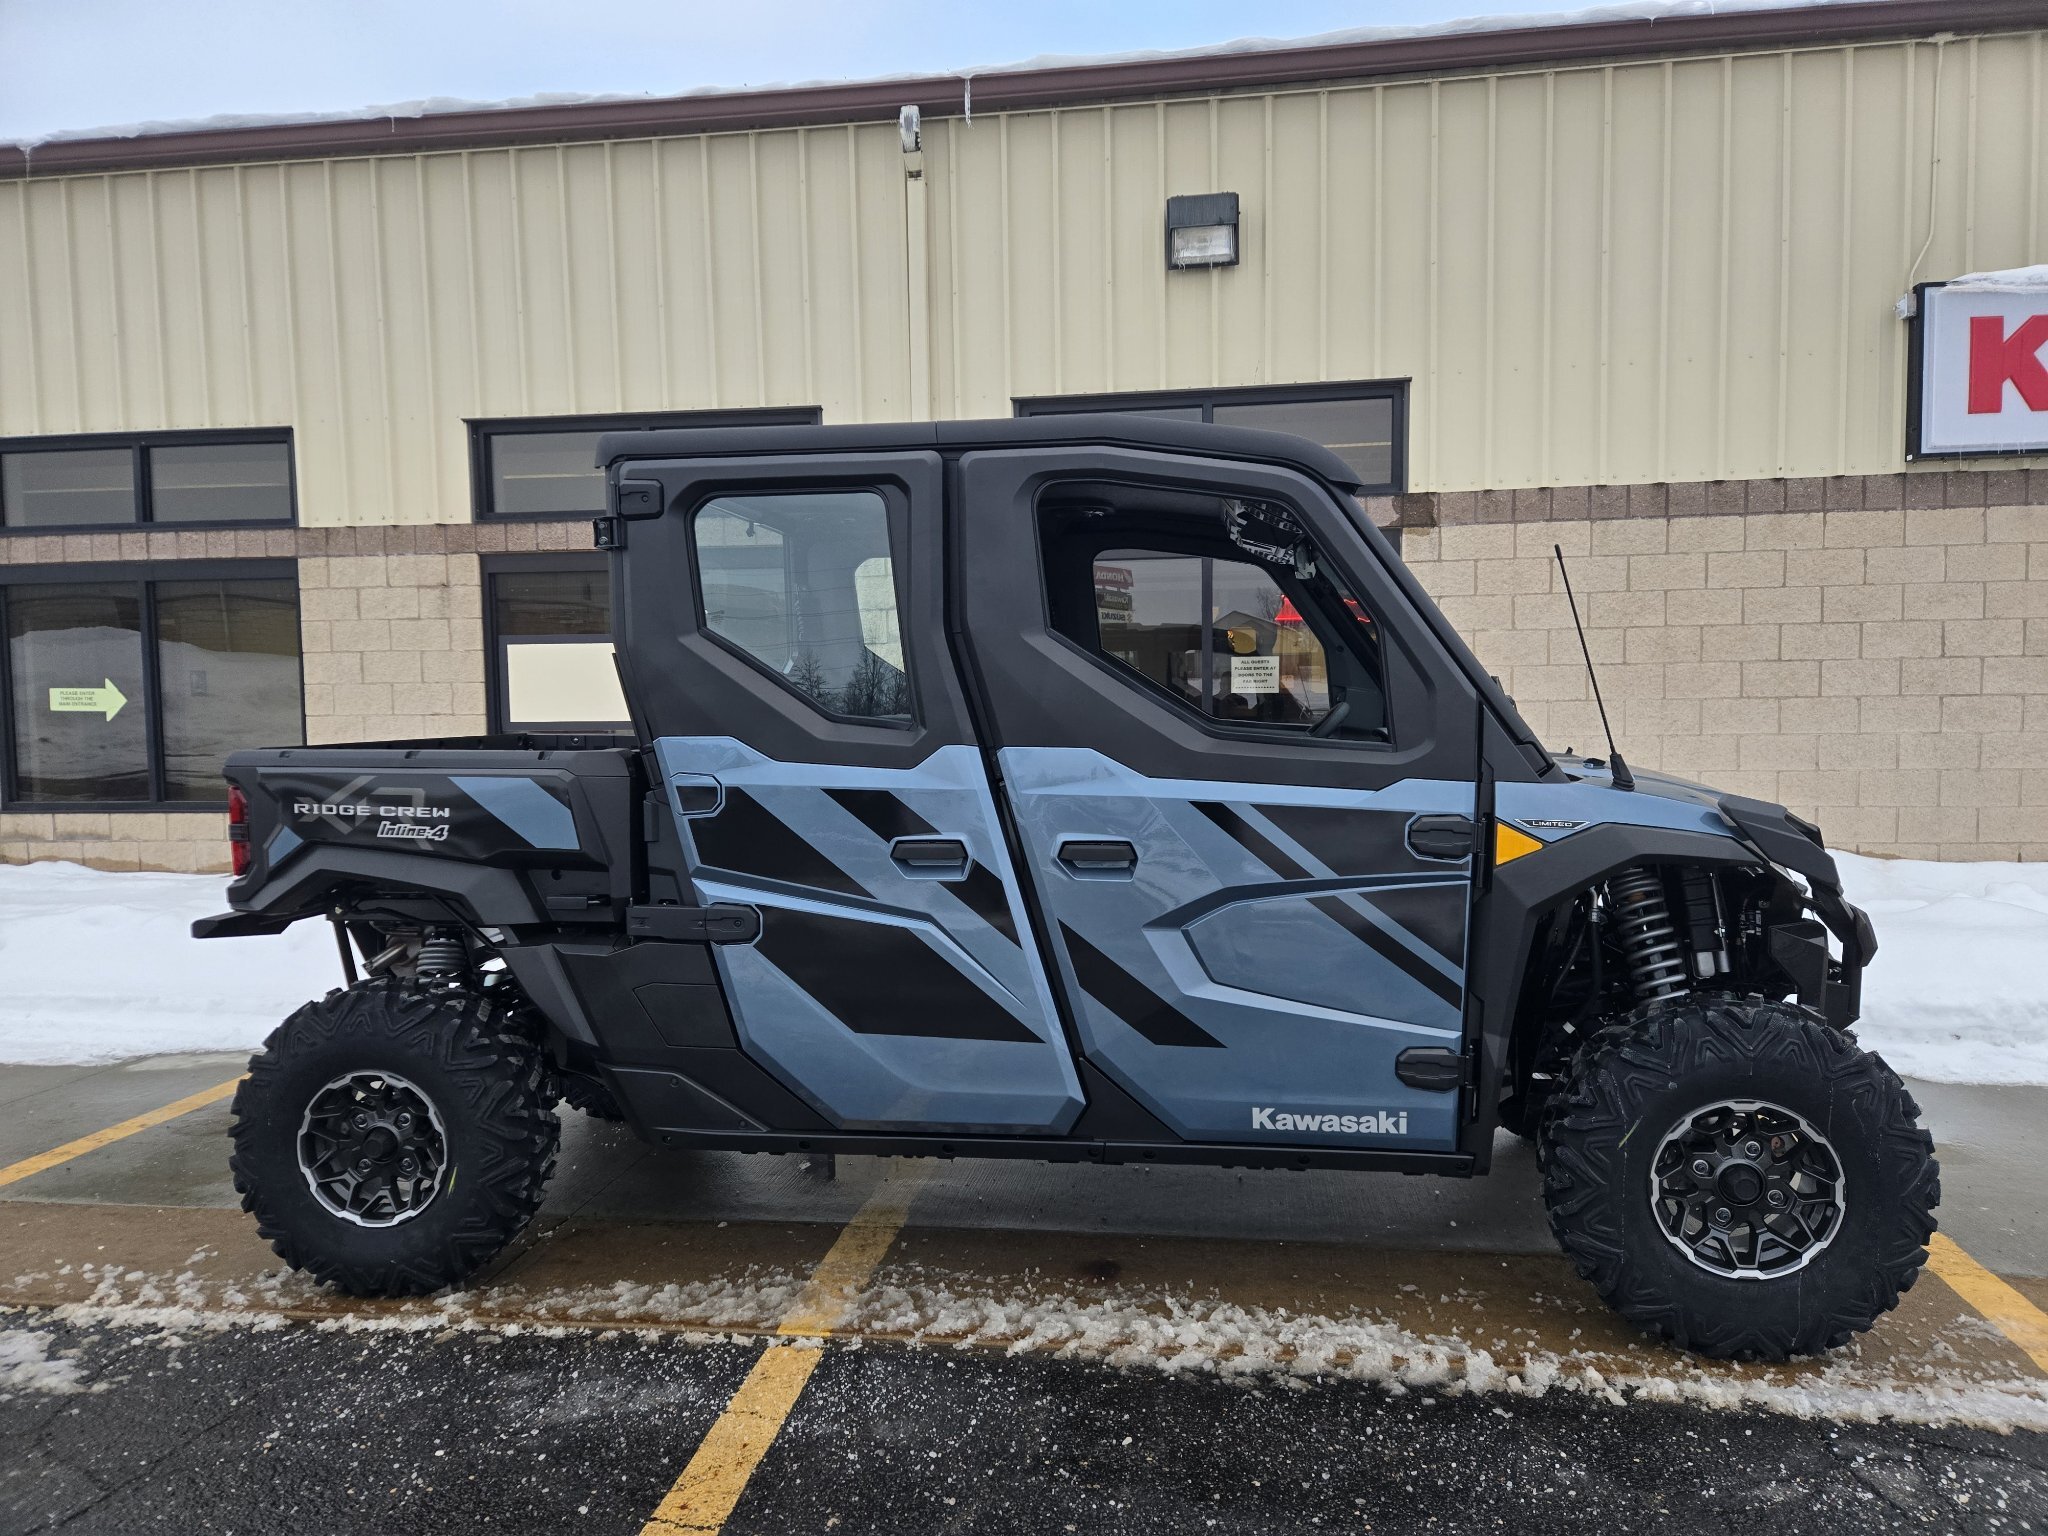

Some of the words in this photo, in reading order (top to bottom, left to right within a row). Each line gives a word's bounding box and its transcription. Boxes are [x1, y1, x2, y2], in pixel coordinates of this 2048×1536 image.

[293, 803, 371, 816] RIDGE
[379, 806, 450, 818] CREW
[376, 821, 449, 841] Inline-4
[1251, 1107, 1408, 1135] Kawasaki
